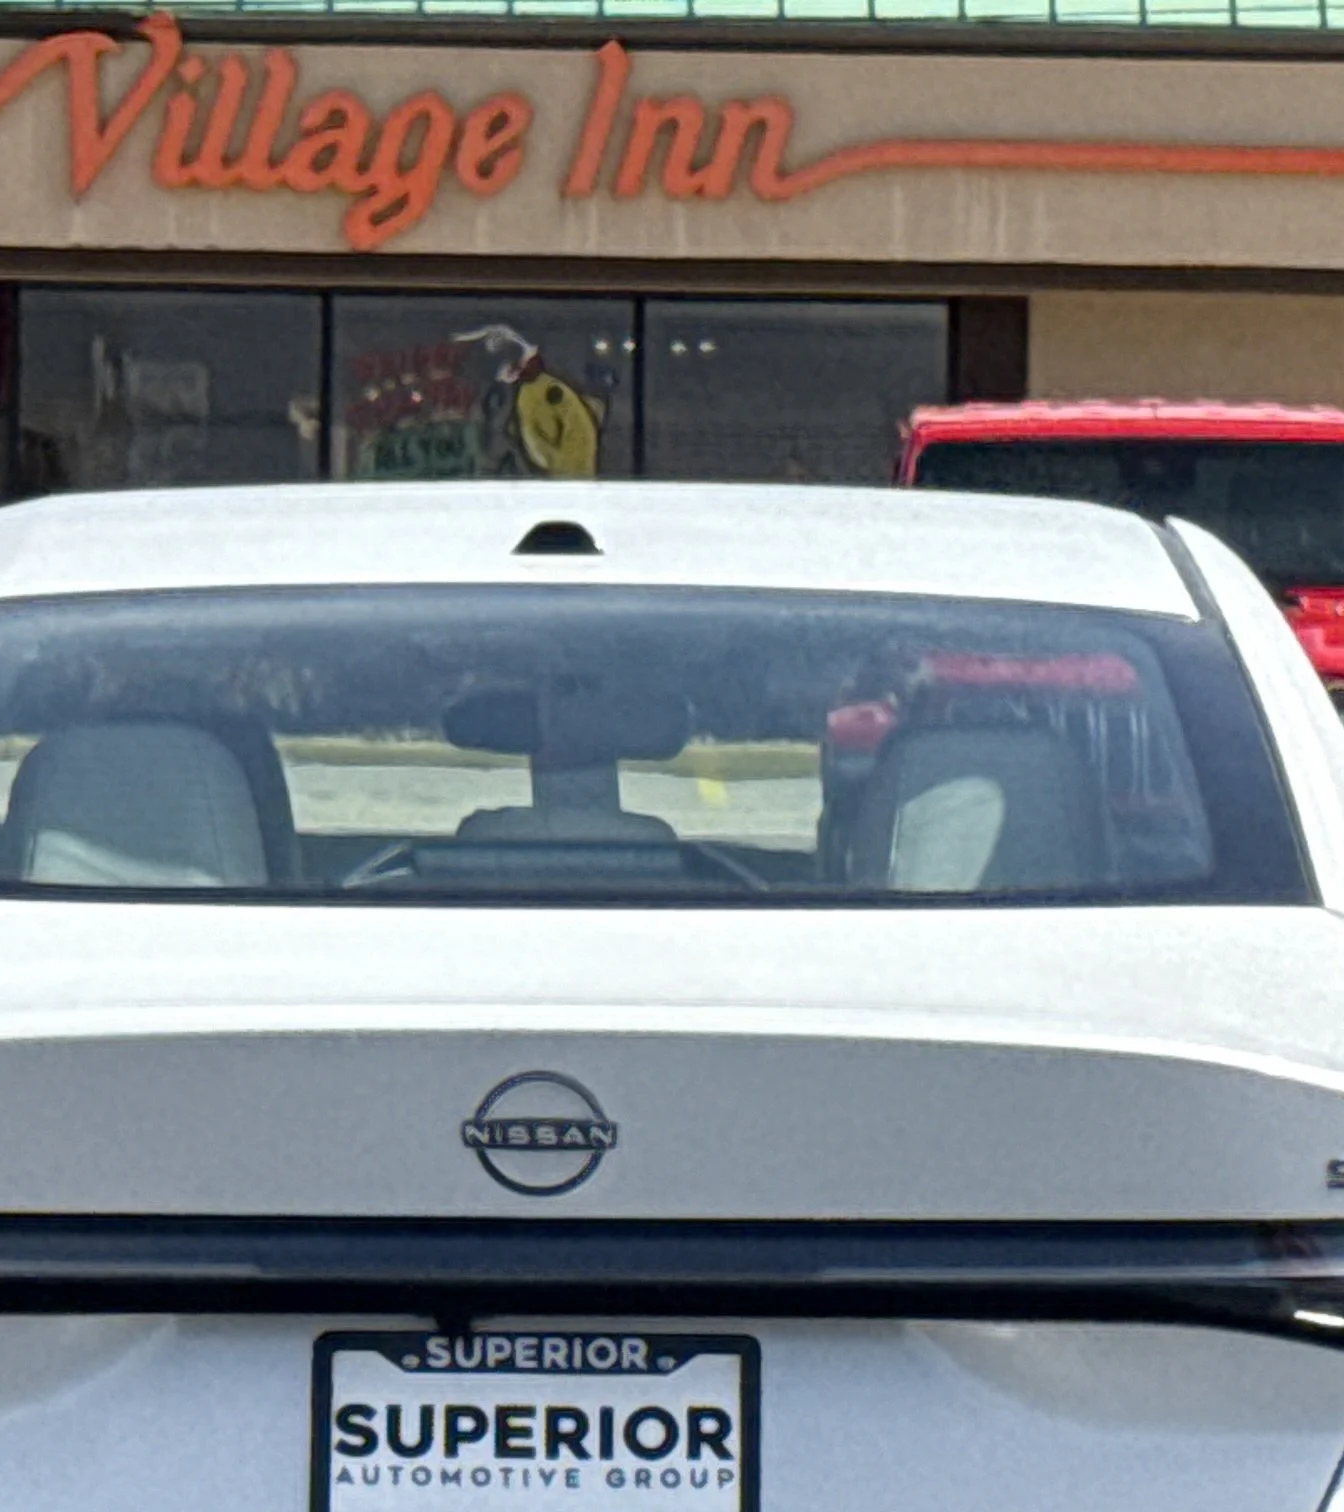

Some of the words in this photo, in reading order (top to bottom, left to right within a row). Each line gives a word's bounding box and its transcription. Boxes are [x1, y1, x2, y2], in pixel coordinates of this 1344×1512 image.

[48, 10, 533, 252] Village
[561, 40, 804, 201] Inn
[464, 1123, 614, 1147] NISSAN
[425, 1336, 649, 1371] SUPERIOR
[334, 1403, 735, 1461] SUPERIOR
[335, 1465, 581, 1489] AUTOMOTIVE
[605, 1467, 735, 1490] GROUP
